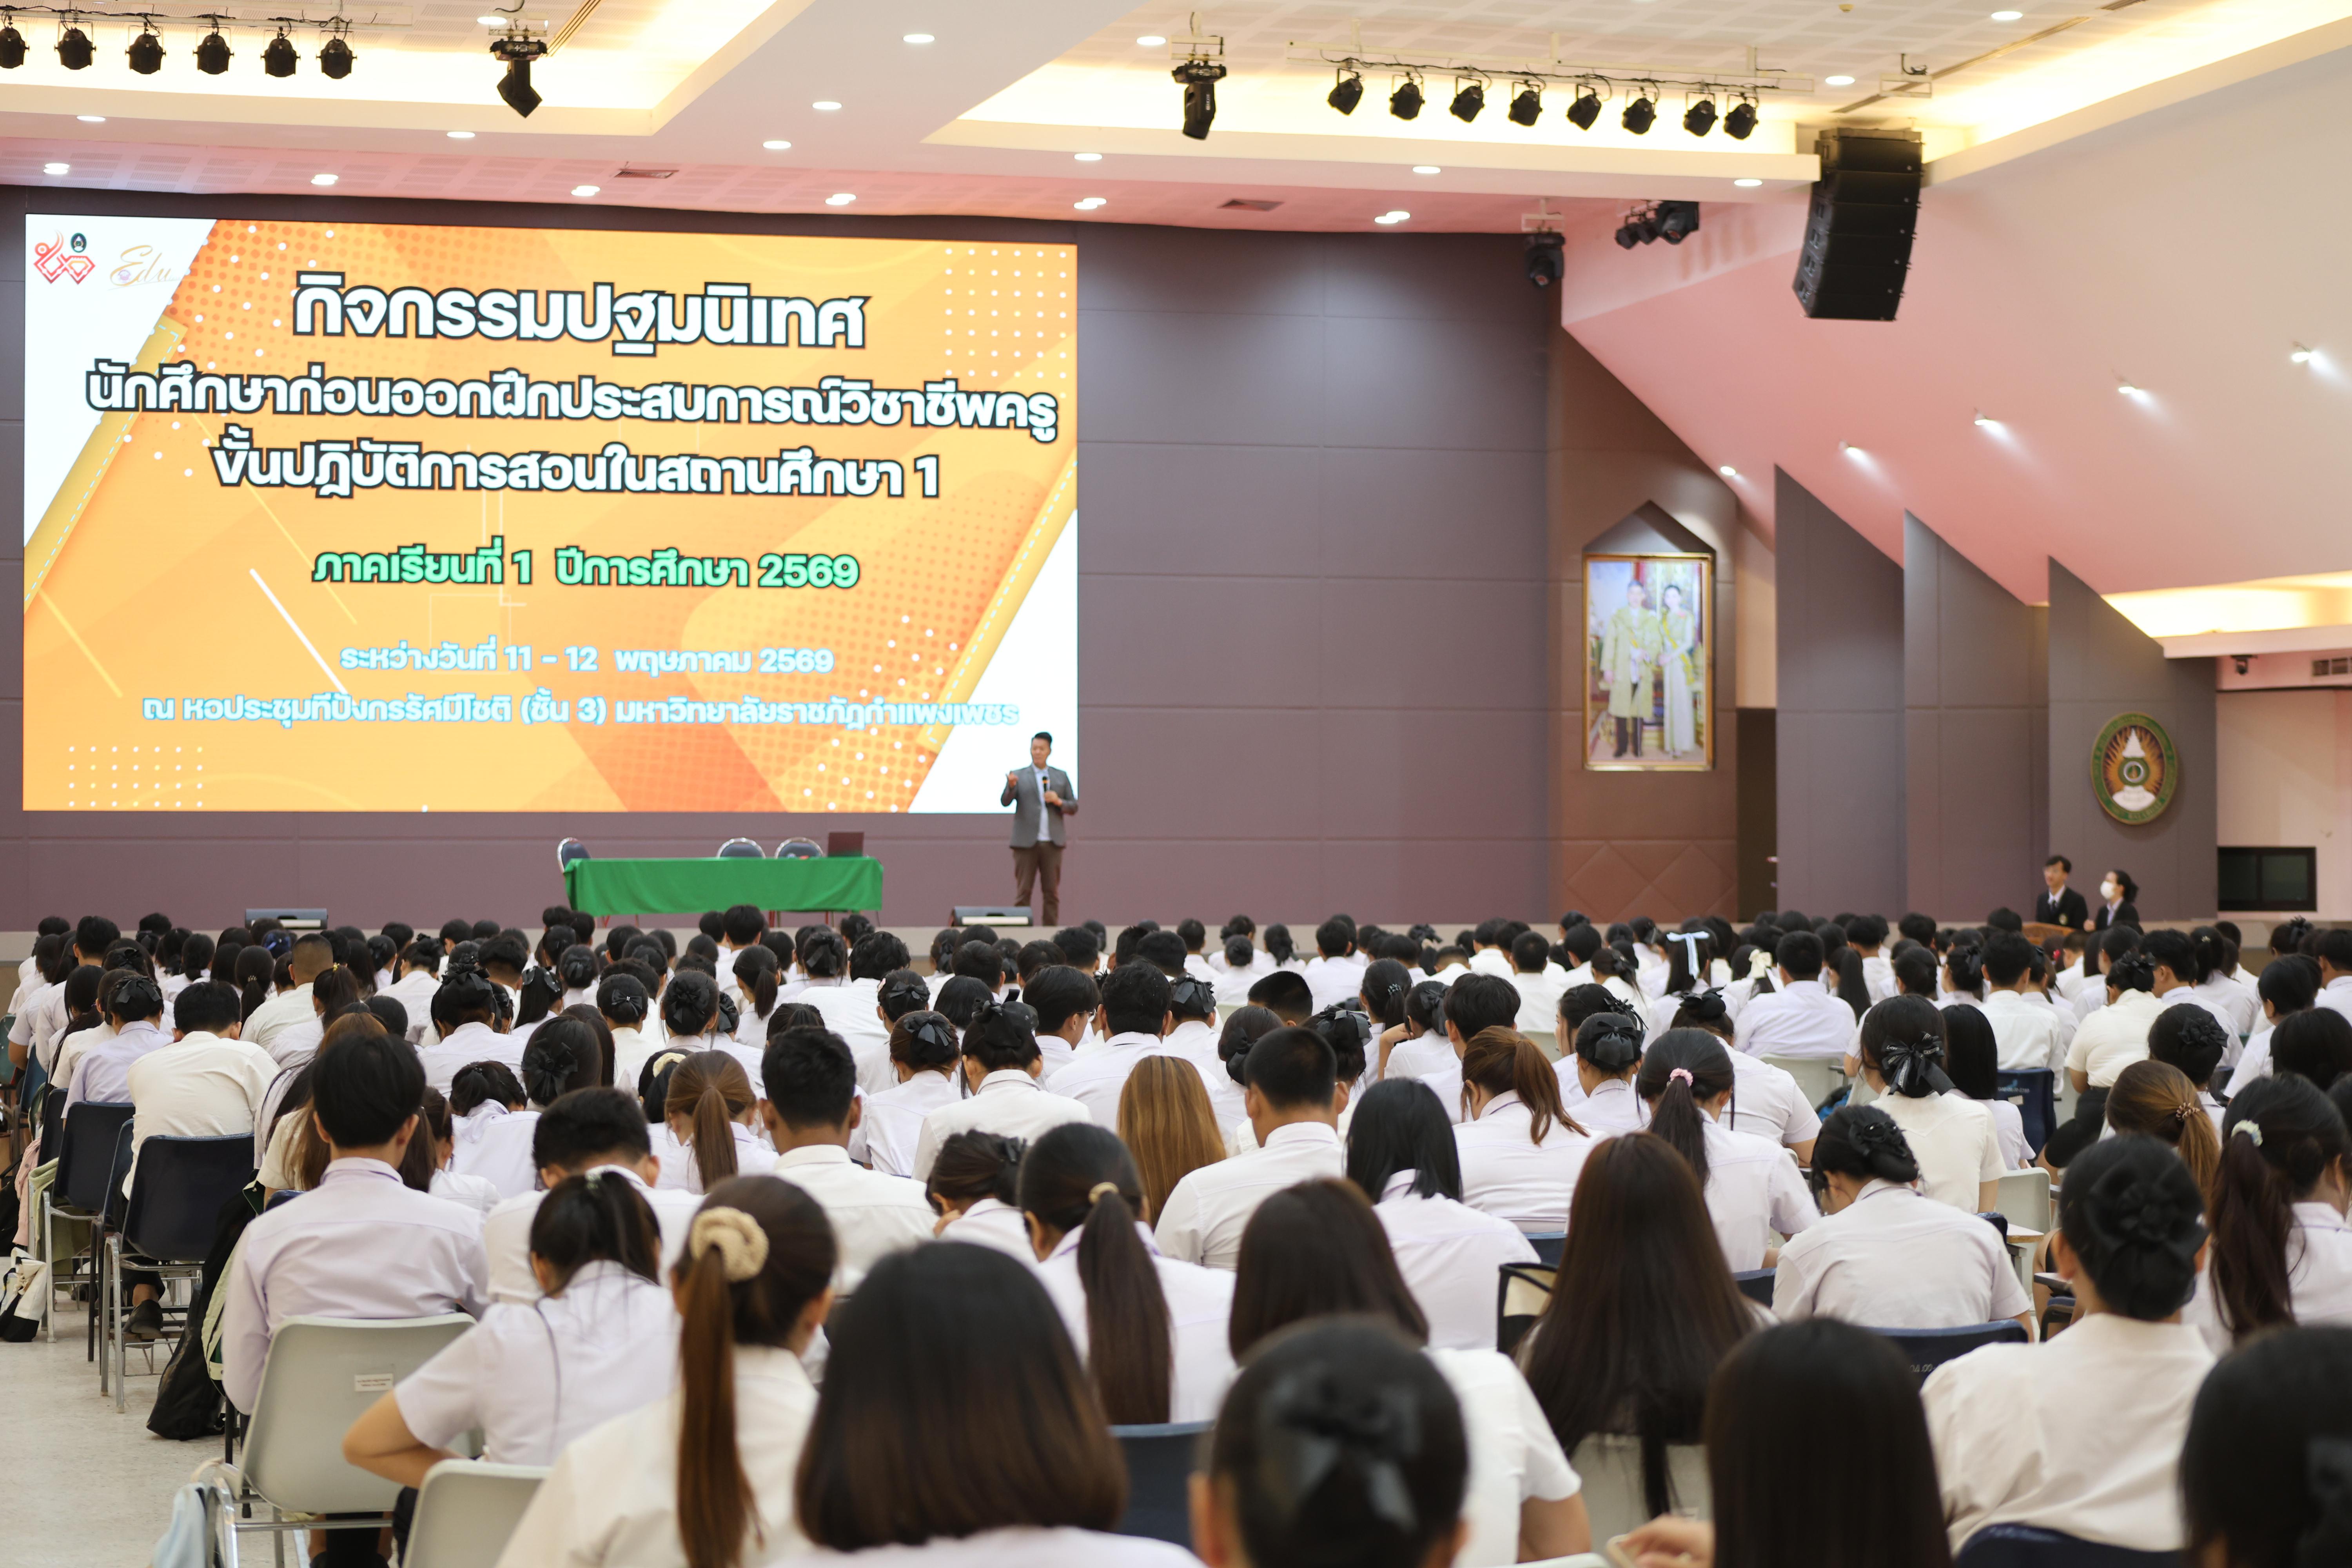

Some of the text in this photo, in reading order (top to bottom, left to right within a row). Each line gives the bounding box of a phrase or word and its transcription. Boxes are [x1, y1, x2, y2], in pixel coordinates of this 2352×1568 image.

[294, 271, 870, 357] กิจกรรมปฐมนิเทศ
[87, 358, 1058, 443] นักศึกษาก่อนออกฝึกประสบการณ์วิชาชีพครู
[208, 423, 939, 498] ขั้นปฏิบัติการสอนในสถานศึกษา 1
[311, 535, 860, 589] ภาคเรียนที่ 1 ปีการศึกษา 2569
[339, 635, 497, 671] ระหว่างวันที่
[503, 645, 532, 671] 11
[564, 645, 599, 672] 12
[613, 649, 751, 678] พฤษภาคม
[759, 647, 835, 674] 2569
[142, 686, 1021, 731] ณ หอประชุมทีปังกรรัศมีโชติ (ชั้น 3) มหาวิทยาลัยราชภัฏกำแพงเพชร
